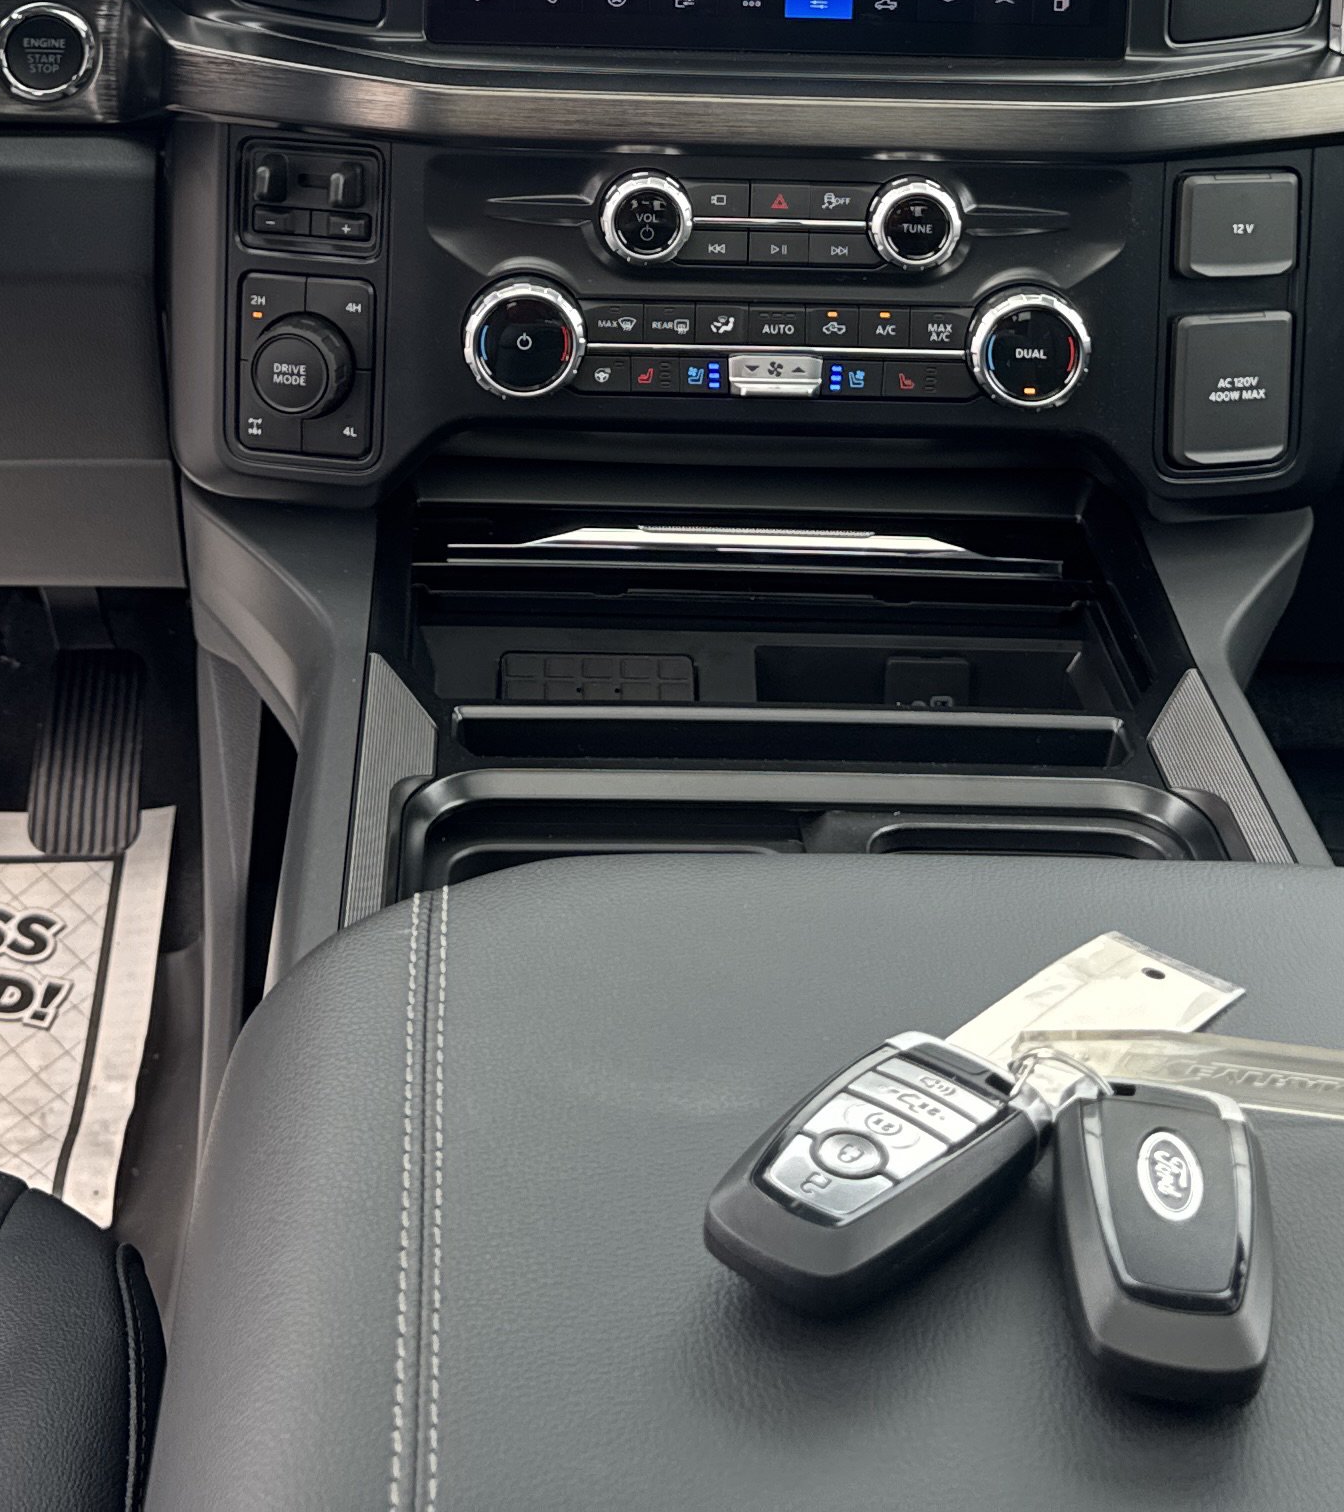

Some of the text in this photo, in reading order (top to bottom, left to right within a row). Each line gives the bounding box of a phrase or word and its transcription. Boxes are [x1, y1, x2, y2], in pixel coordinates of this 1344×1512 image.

[23, 37, 66, 49] ENGINE
[27, 53, 62, 64] START
[29, 63, 60, 74] STOP
[834, 196, 850, 205] OFF
[636, 213, 659, 223] VOL
[902, 223, 933, 234] TUNE
[250, 295, 266, 306] 2H
[345, 303, 362, 313] 4H
[598, 319, 618, 328] MAX
[652, 320, 674, 330] REAR
[928, 323, 953, 333] MAX
[762, 324, 795, 335] AUTO
[875, 325, 896, 336] A/C
[930, 331, 951, 342] A/C
[1015, 348, 1047, 360] DUAL
[273, 363, 306, 374] DRIVE
[273, 374, 307, 386] MODE
[1217, 376, 1259, 388] AC 120V
[1209, 388, 1266, 402] 400W MAX
[343, 426, 358, 437] 4L
[1152, 1149, 1189, 1200] Ford
